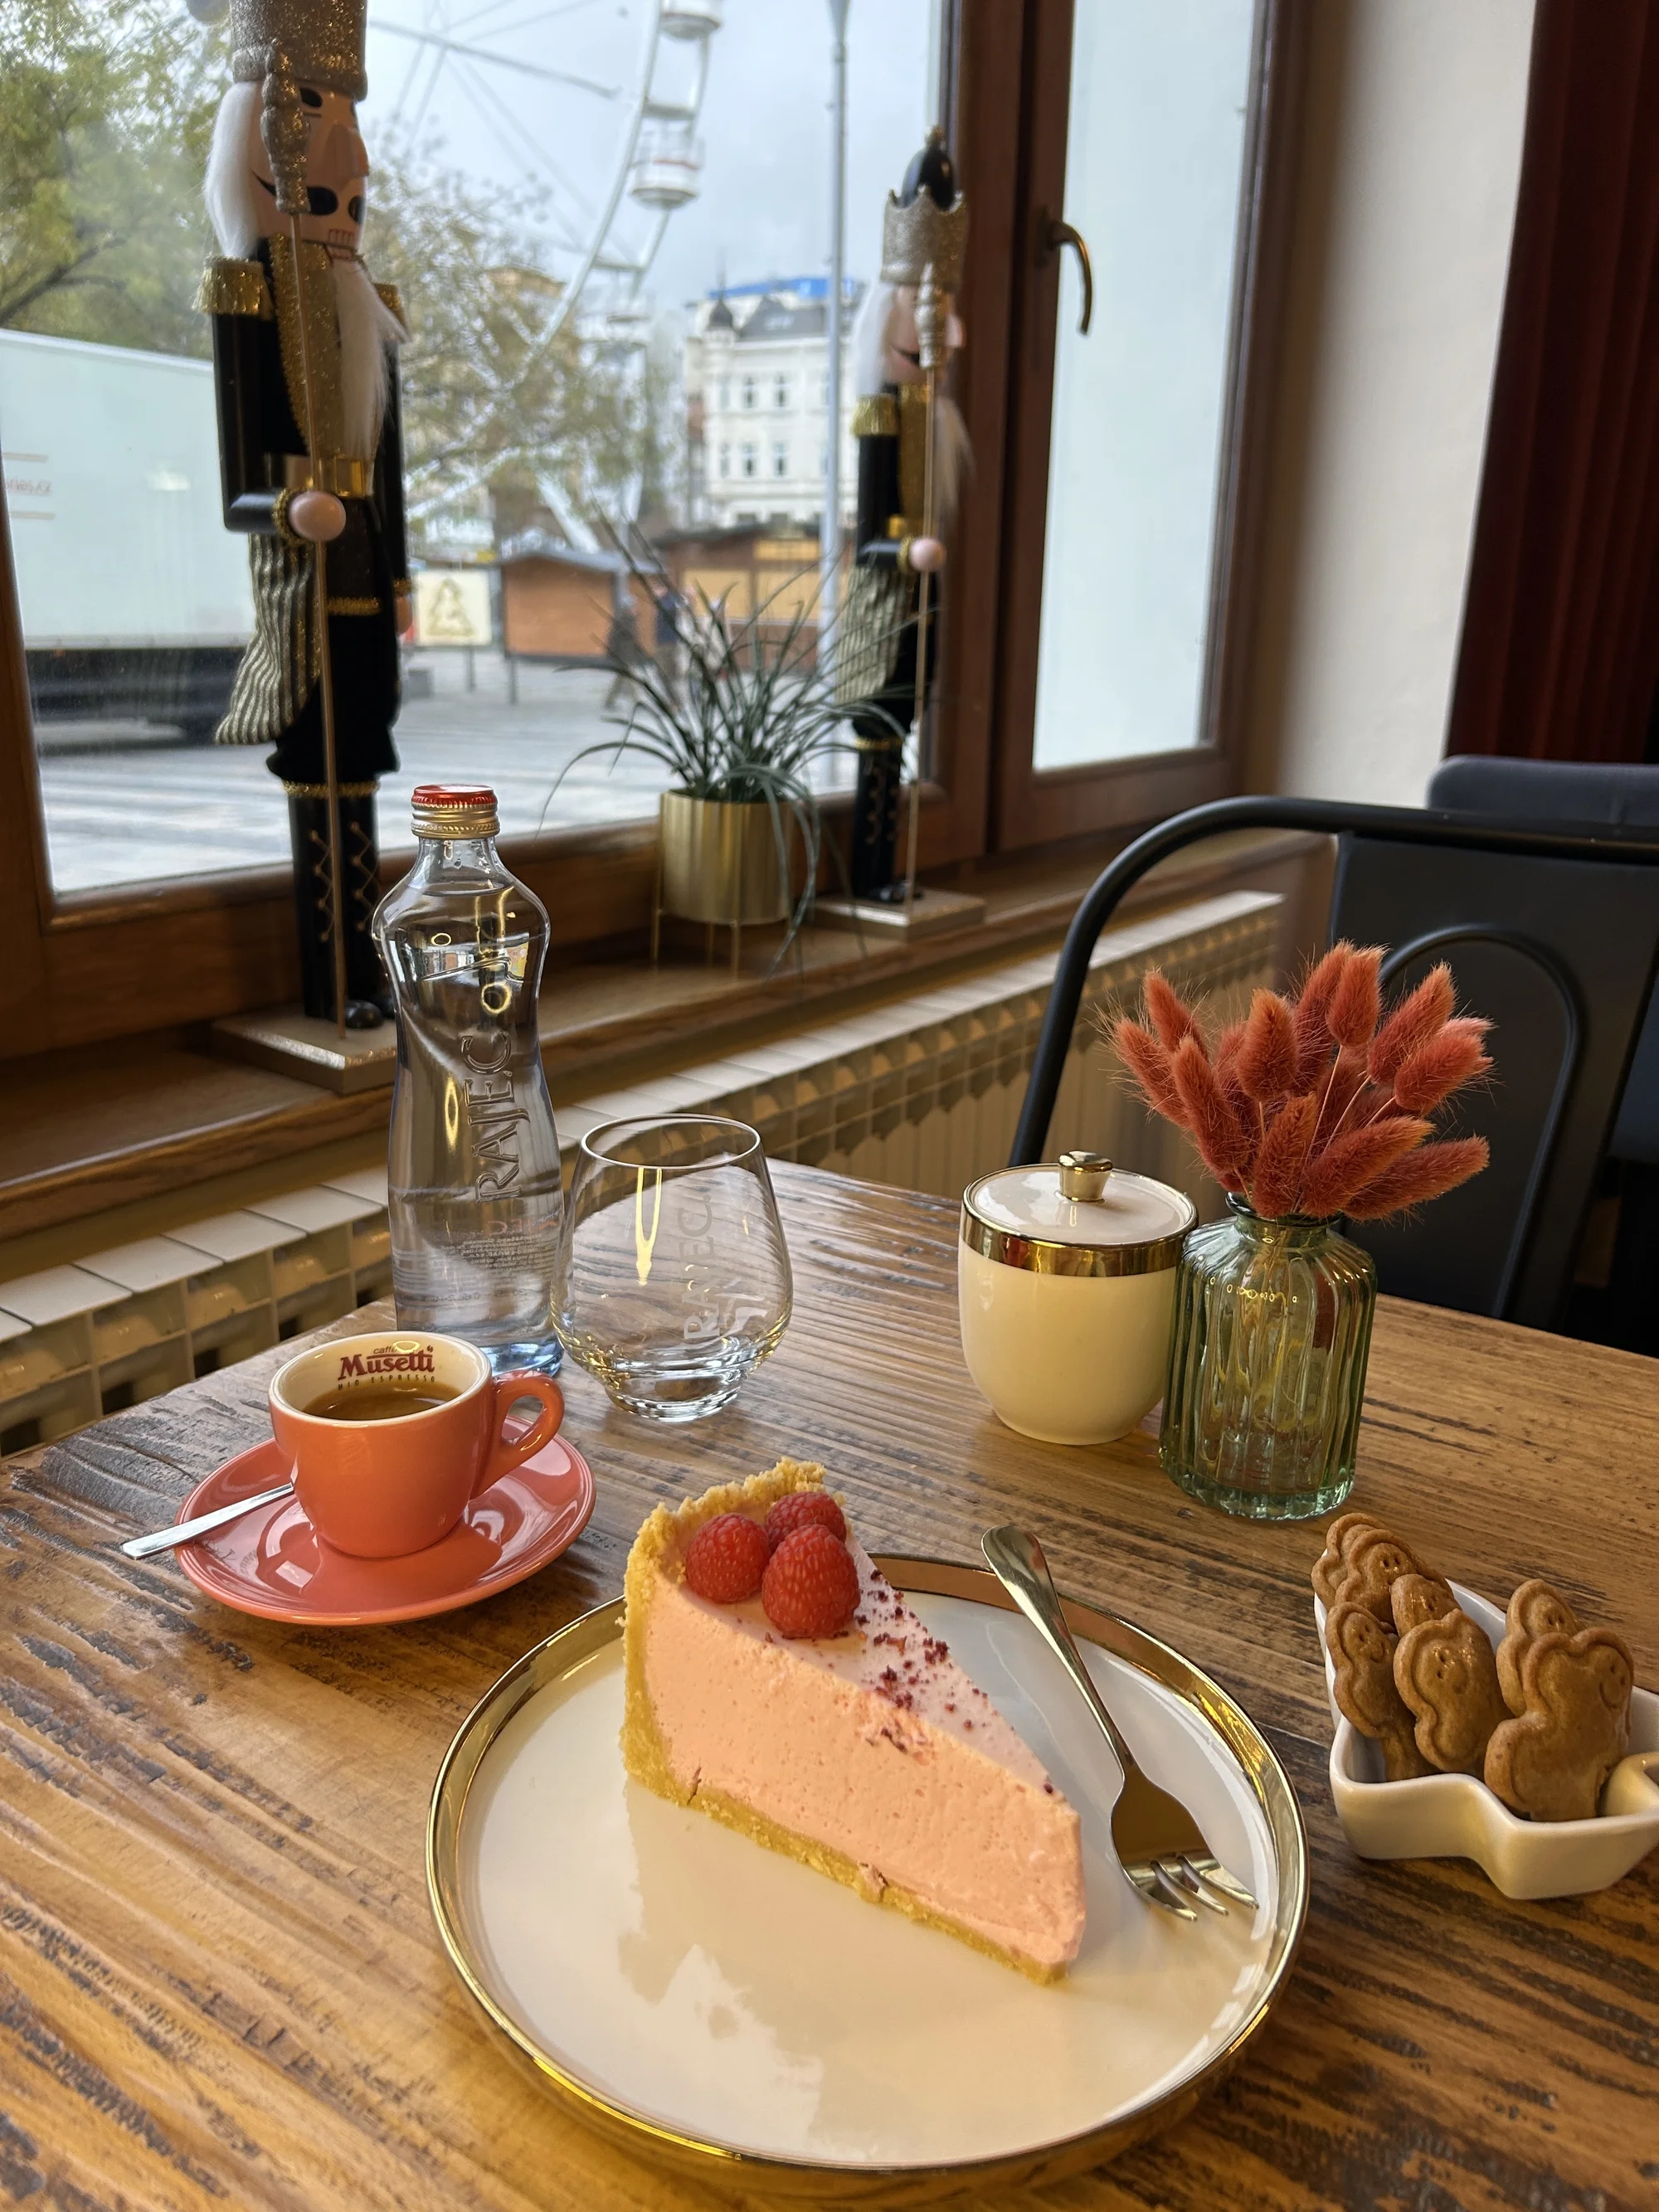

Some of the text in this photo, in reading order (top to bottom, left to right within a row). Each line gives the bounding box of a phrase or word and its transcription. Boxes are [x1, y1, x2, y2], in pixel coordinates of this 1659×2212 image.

[461, 1030, 530, 1204] RAJEC
[338, 1346, 435, 1380] Musetti
[338, 1374, 435, 1390] MIO ESPRESSO
